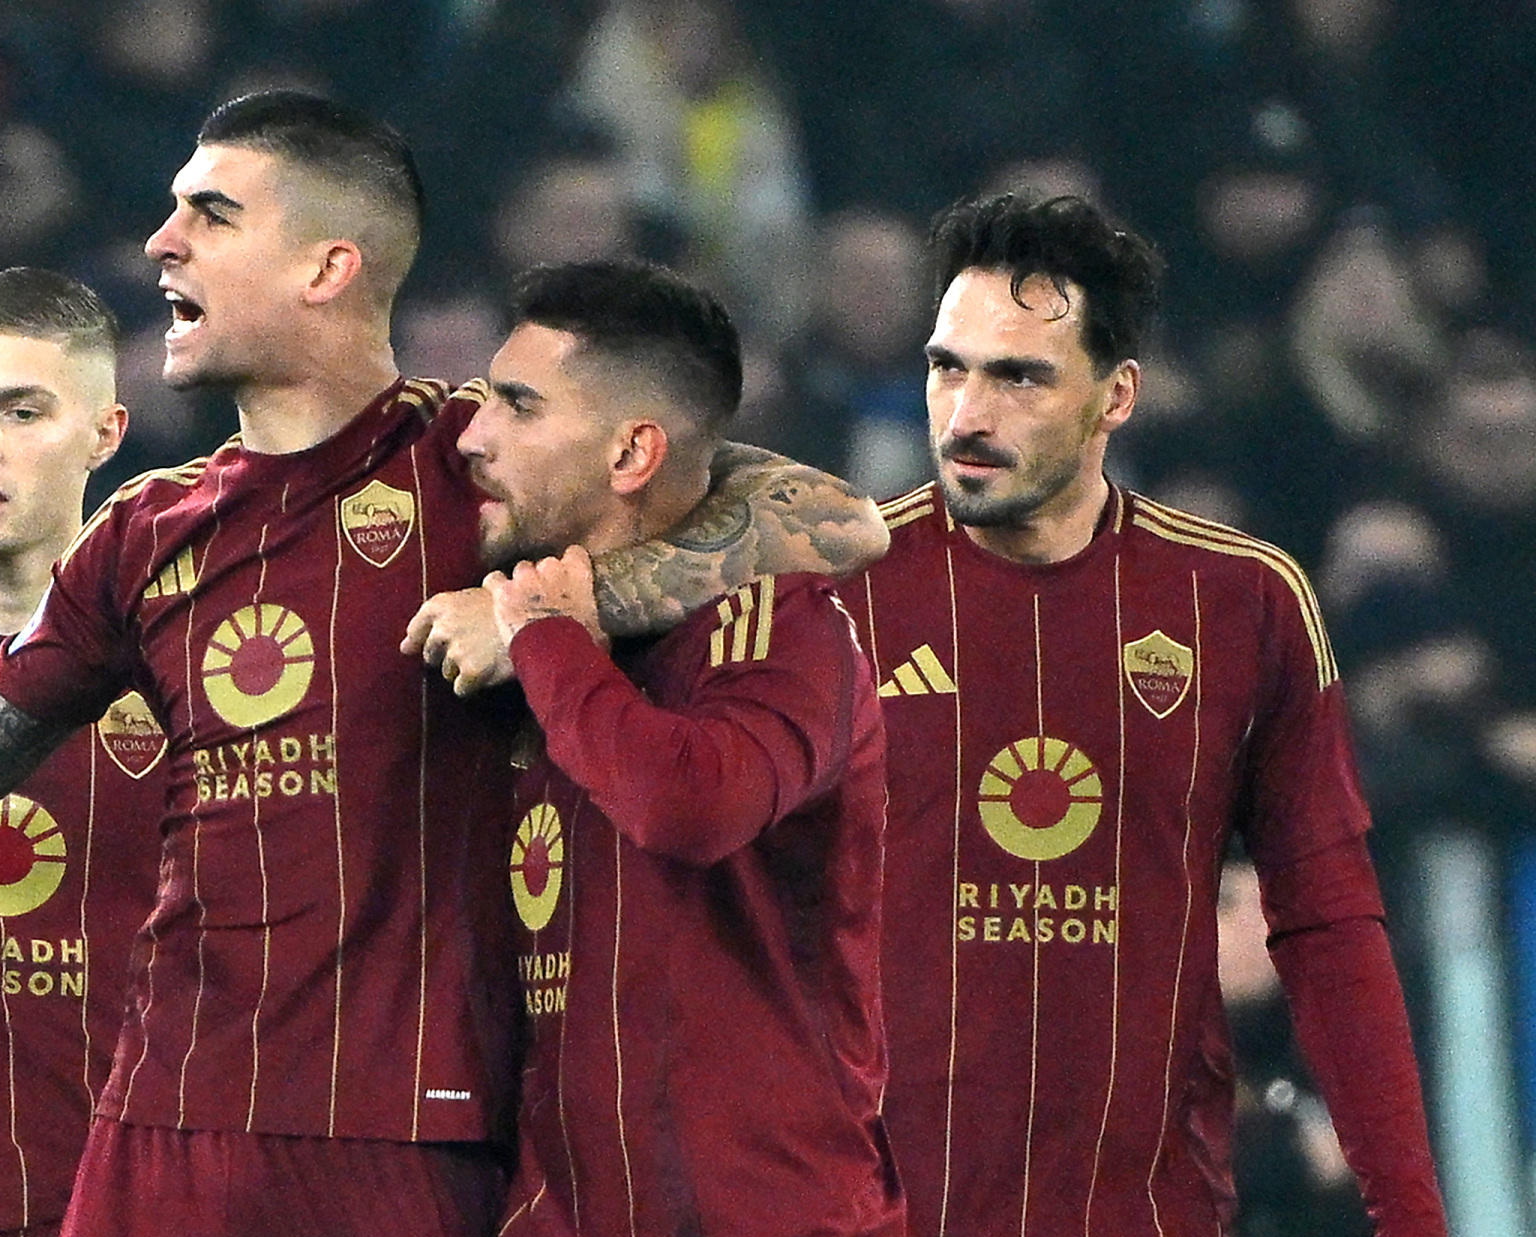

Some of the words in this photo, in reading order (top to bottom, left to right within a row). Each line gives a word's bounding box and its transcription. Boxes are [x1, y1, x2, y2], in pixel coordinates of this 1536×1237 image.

[353, 527, 402, 545] ROMA
[1138, 679, 1181, 694] ROMA
[112, 739, 157, 752] ROMA
[193, 733, 335, 775] RIYADH
[197, 768, 336, 803] SEASON
[959, 882, 1117, 912] RIYADH
[957, 915, 1117, 945] SEASON
